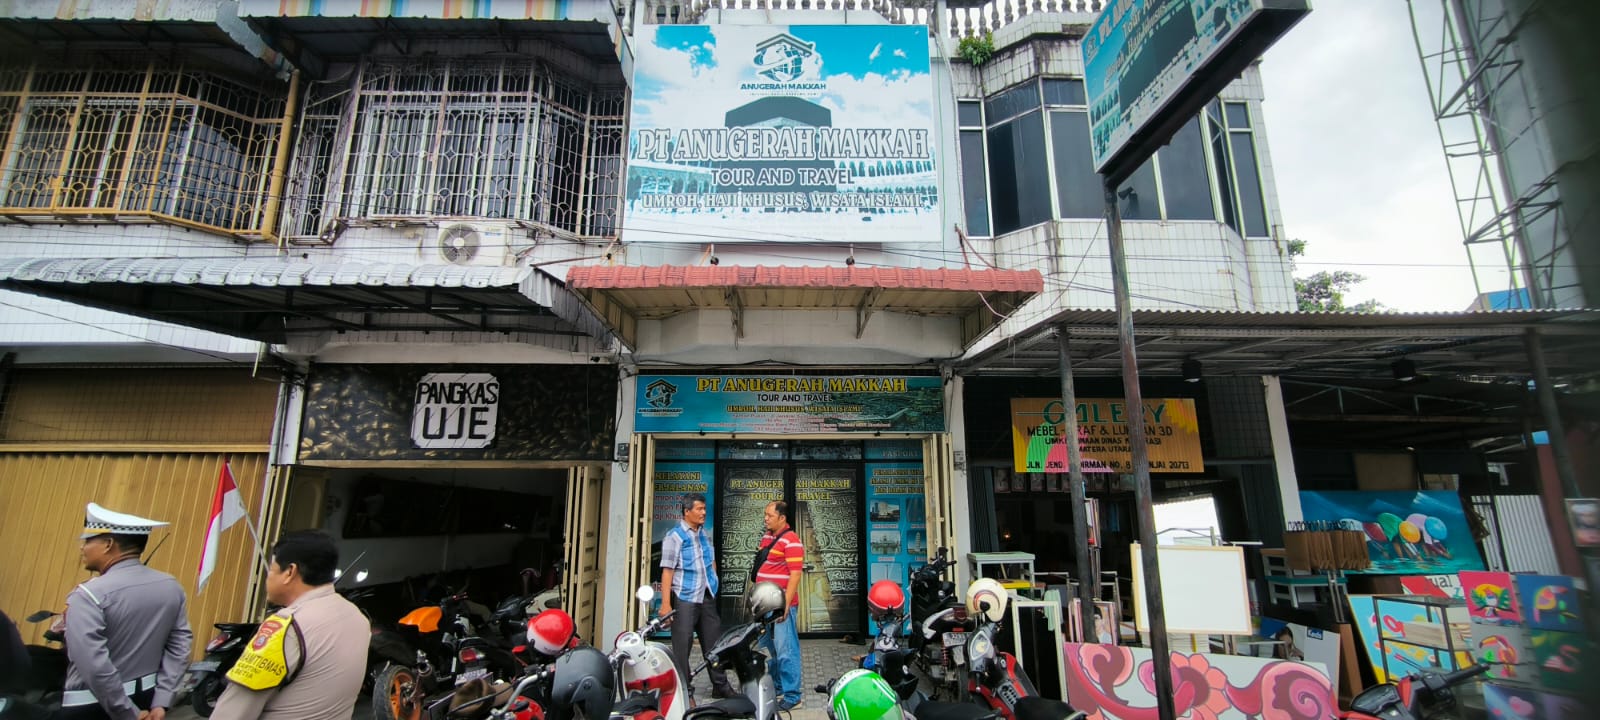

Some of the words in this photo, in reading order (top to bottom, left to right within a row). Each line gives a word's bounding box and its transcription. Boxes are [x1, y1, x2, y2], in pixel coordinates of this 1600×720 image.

[638, 128, 672, 160] PT
[673, 127, 815, 160] ANUGERAH
[819, 128, 929, 159] MAKKAH
[712, 169, 754, 185] TOUR
[758, 169, 796, 184] AND
[798, 169, 854, 185] TRAVEL
[642, 193, 703, 209] UMROH,
[704, 193, 738, 208] HAJI
[740, 193, 809, 209] KHUSUS,
[810, 192, 863, 208] WISATA
[697, 378, 720, 392] PT
[722, 377, 824, 392] ANUGERAH
[828, 378, 907, 392] MAKKAH
[415, 382, 499, 404] PANGKAS
[757, 394, 780, 402] TOUR
[804, 394, 833, 402] TRAVEL
[422, 407, 489, 439] UJE
[1099, 425, 1108, 436] &
[1113, 425, 1155, 436] LUAN
[1159, 425, 1173, 436] 3D
[1045, 437, 1067, 445] UMK
[1148, 461, 1166, 469] NJAI
[655, 482, 707, 491] ERJALANAN
[810, 480, 850, 488] MAKKAH
[750, 492, 773, 500] TOUR
[797, 492, 831, 500] TRAVEL
